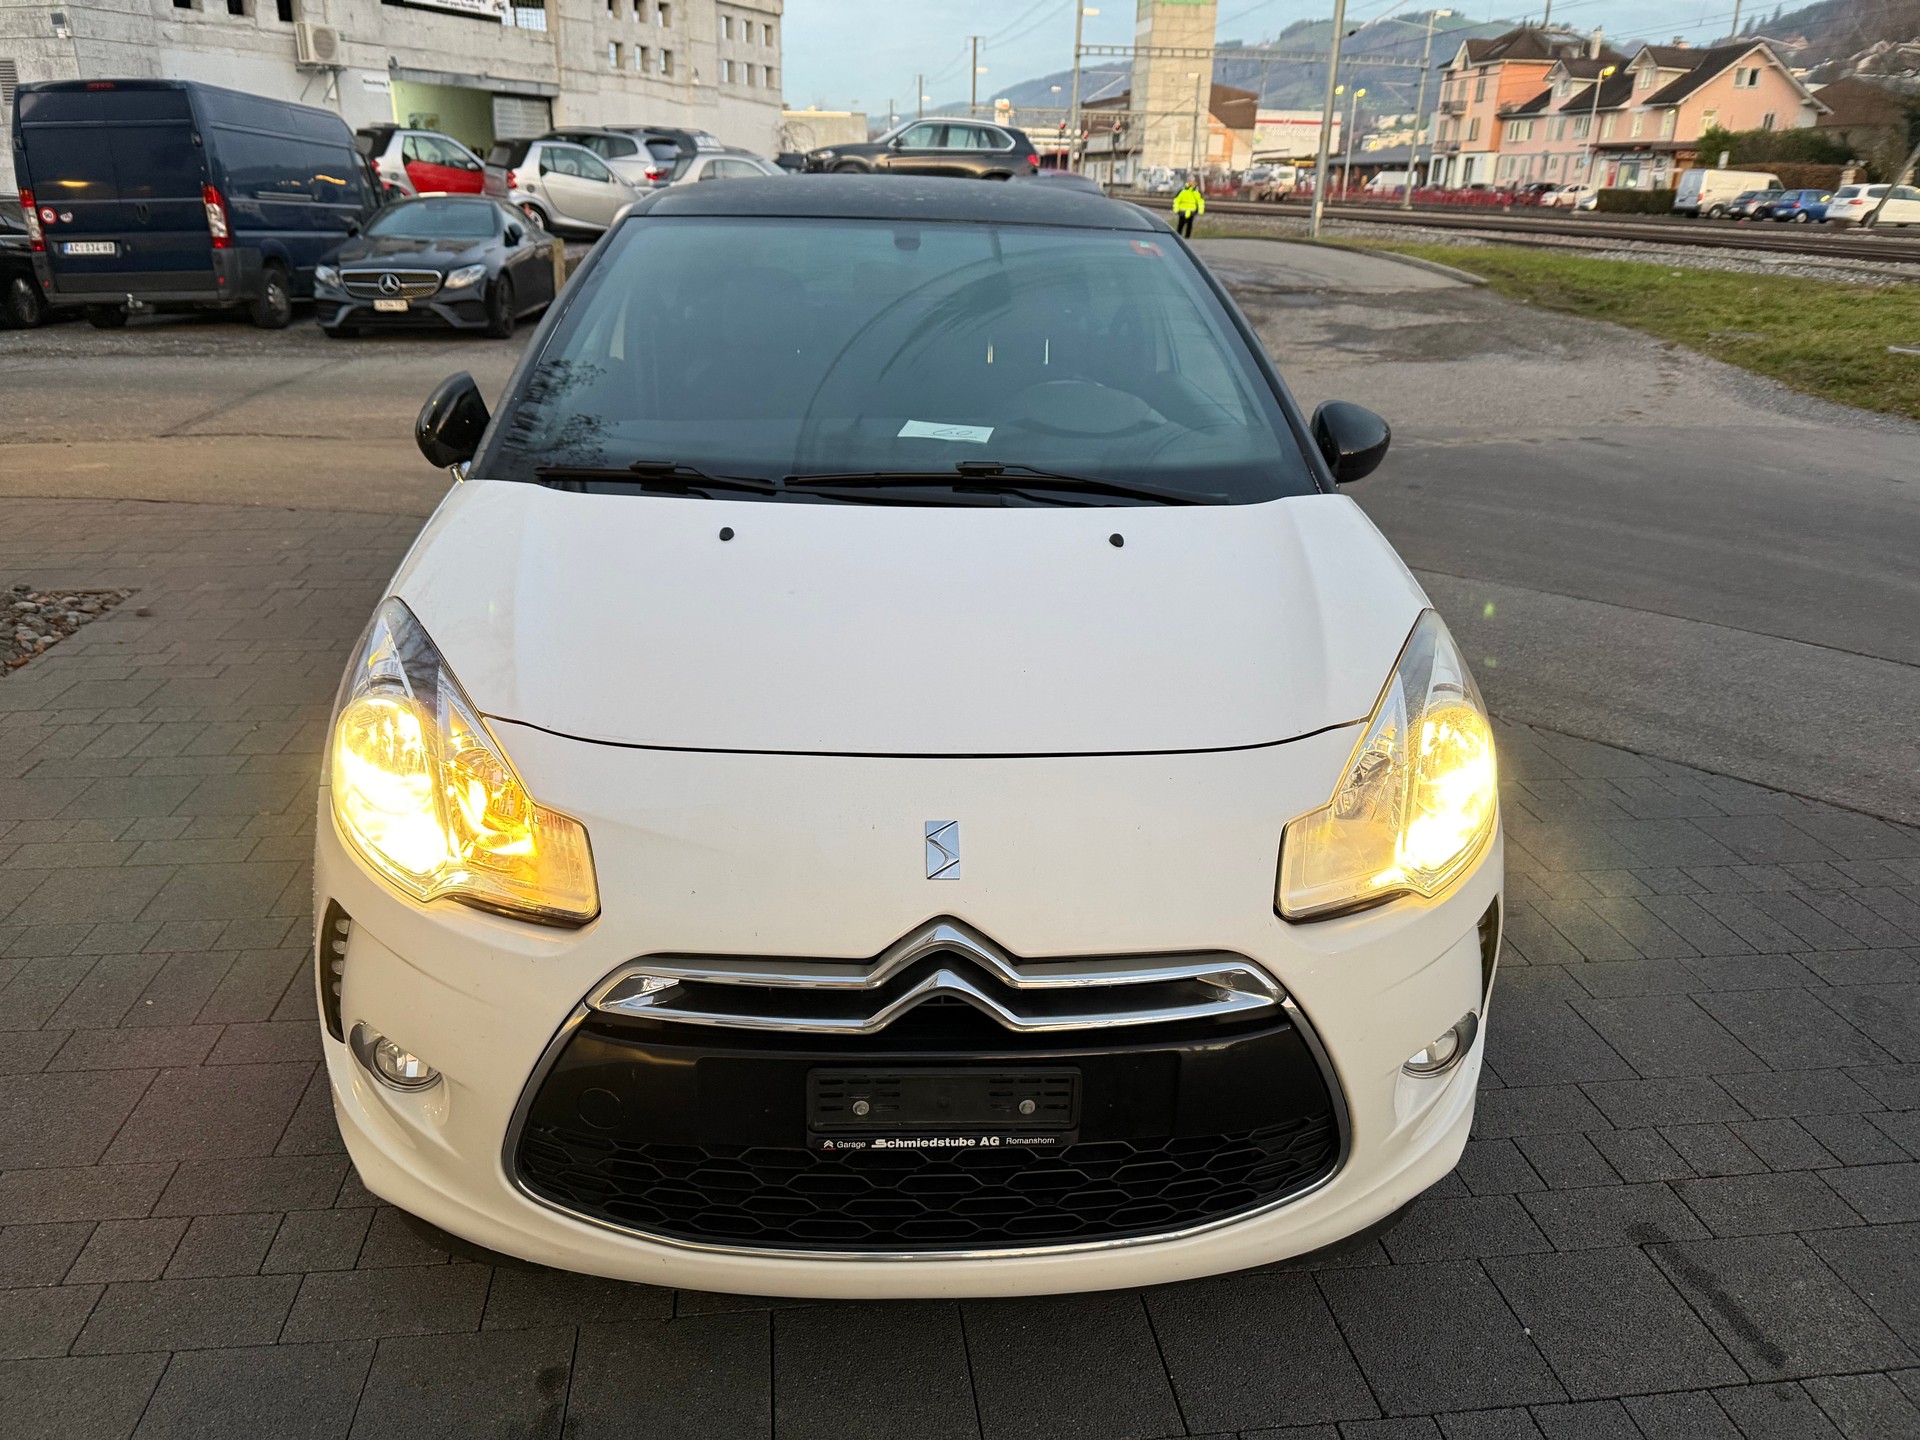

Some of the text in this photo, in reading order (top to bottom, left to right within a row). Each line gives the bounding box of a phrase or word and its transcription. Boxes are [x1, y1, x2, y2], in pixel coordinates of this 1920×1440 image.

[836, 1136, 1055, 1149] Garage Schmiedstube AG Romanshorn
